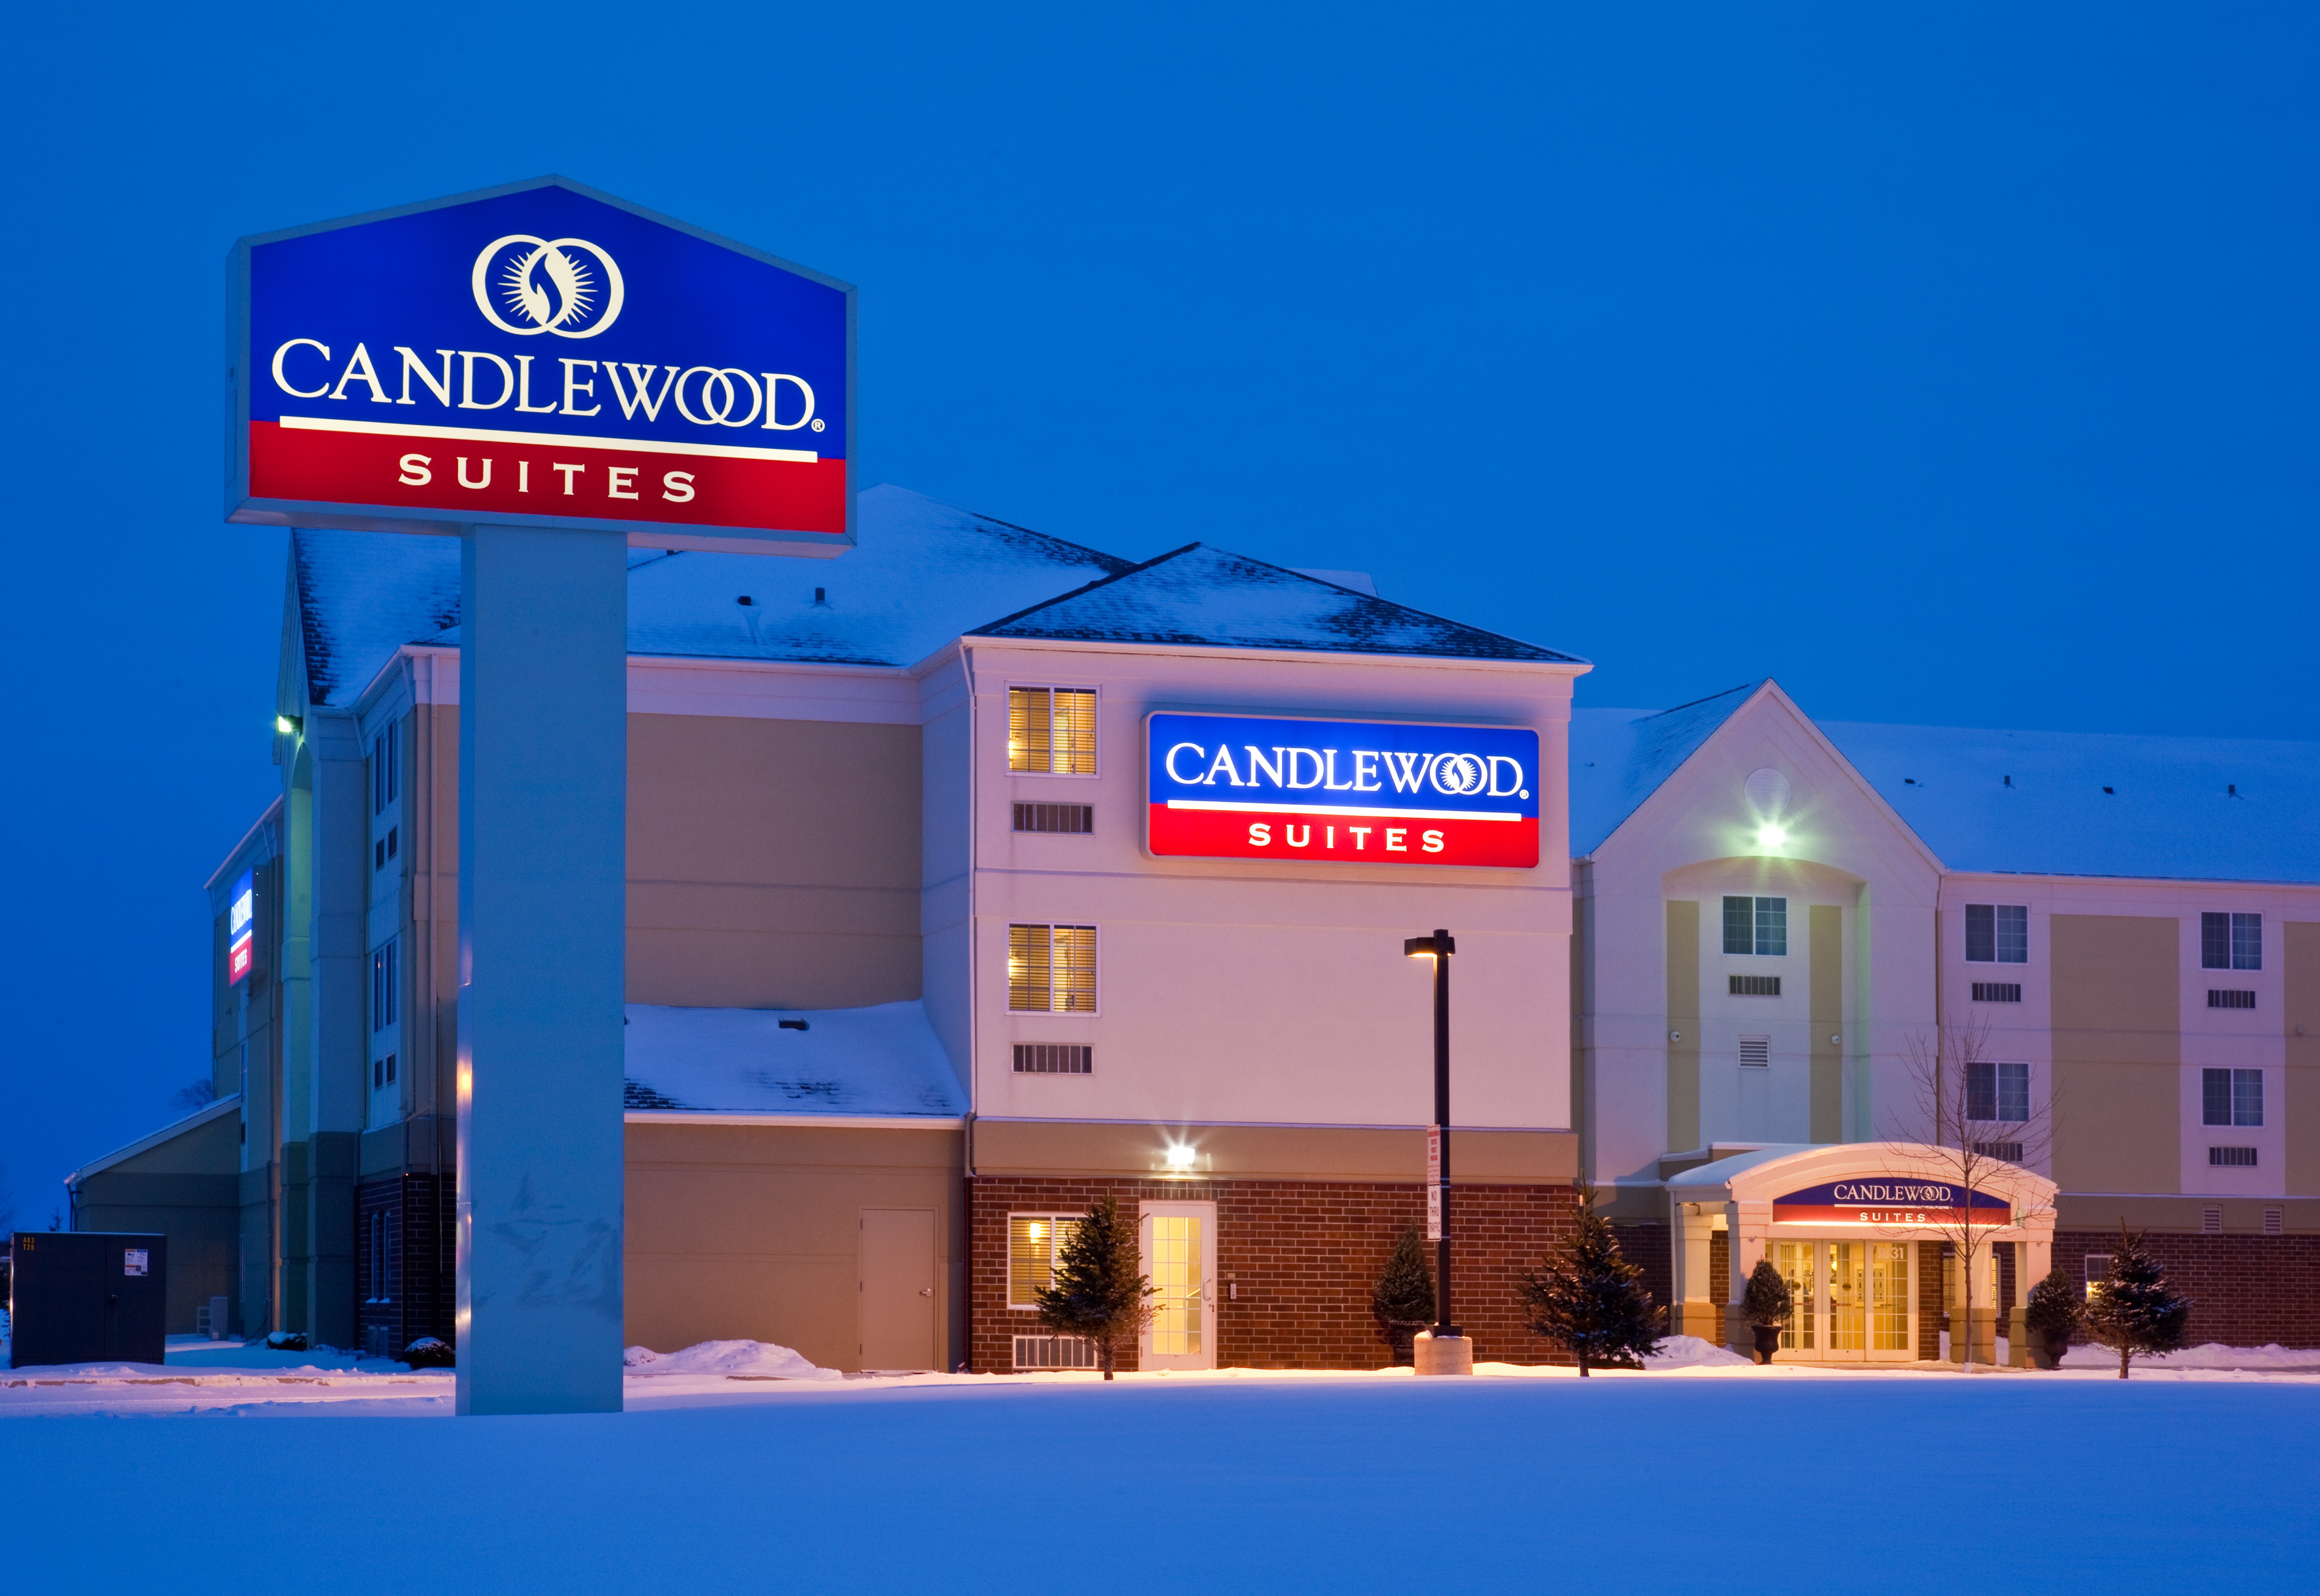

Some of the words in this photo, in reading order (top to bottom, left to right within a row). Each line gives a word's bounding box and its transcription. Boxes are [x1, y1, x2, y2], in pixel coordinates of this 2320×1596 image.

[272, 338, 815, 430] CANDLEWOOD
[398, 454, 695, 503] SUITES
[1166, 743, 1523, 796] CANDLEWOOD
[1248, 823, 1445, 853] SUITES
[1431, 1191, 1437, 1201] NO
[1834, 1185, 1950, 1201] CANDLEWOOD
[1429, 1207, 1439, 1217] THRU
[1860, 1212, 1925, 1223] SUITES
[1428, 1222, 1440, 1232] TRAFFIC
[1877, 1247, 1904, 1259] 1831
